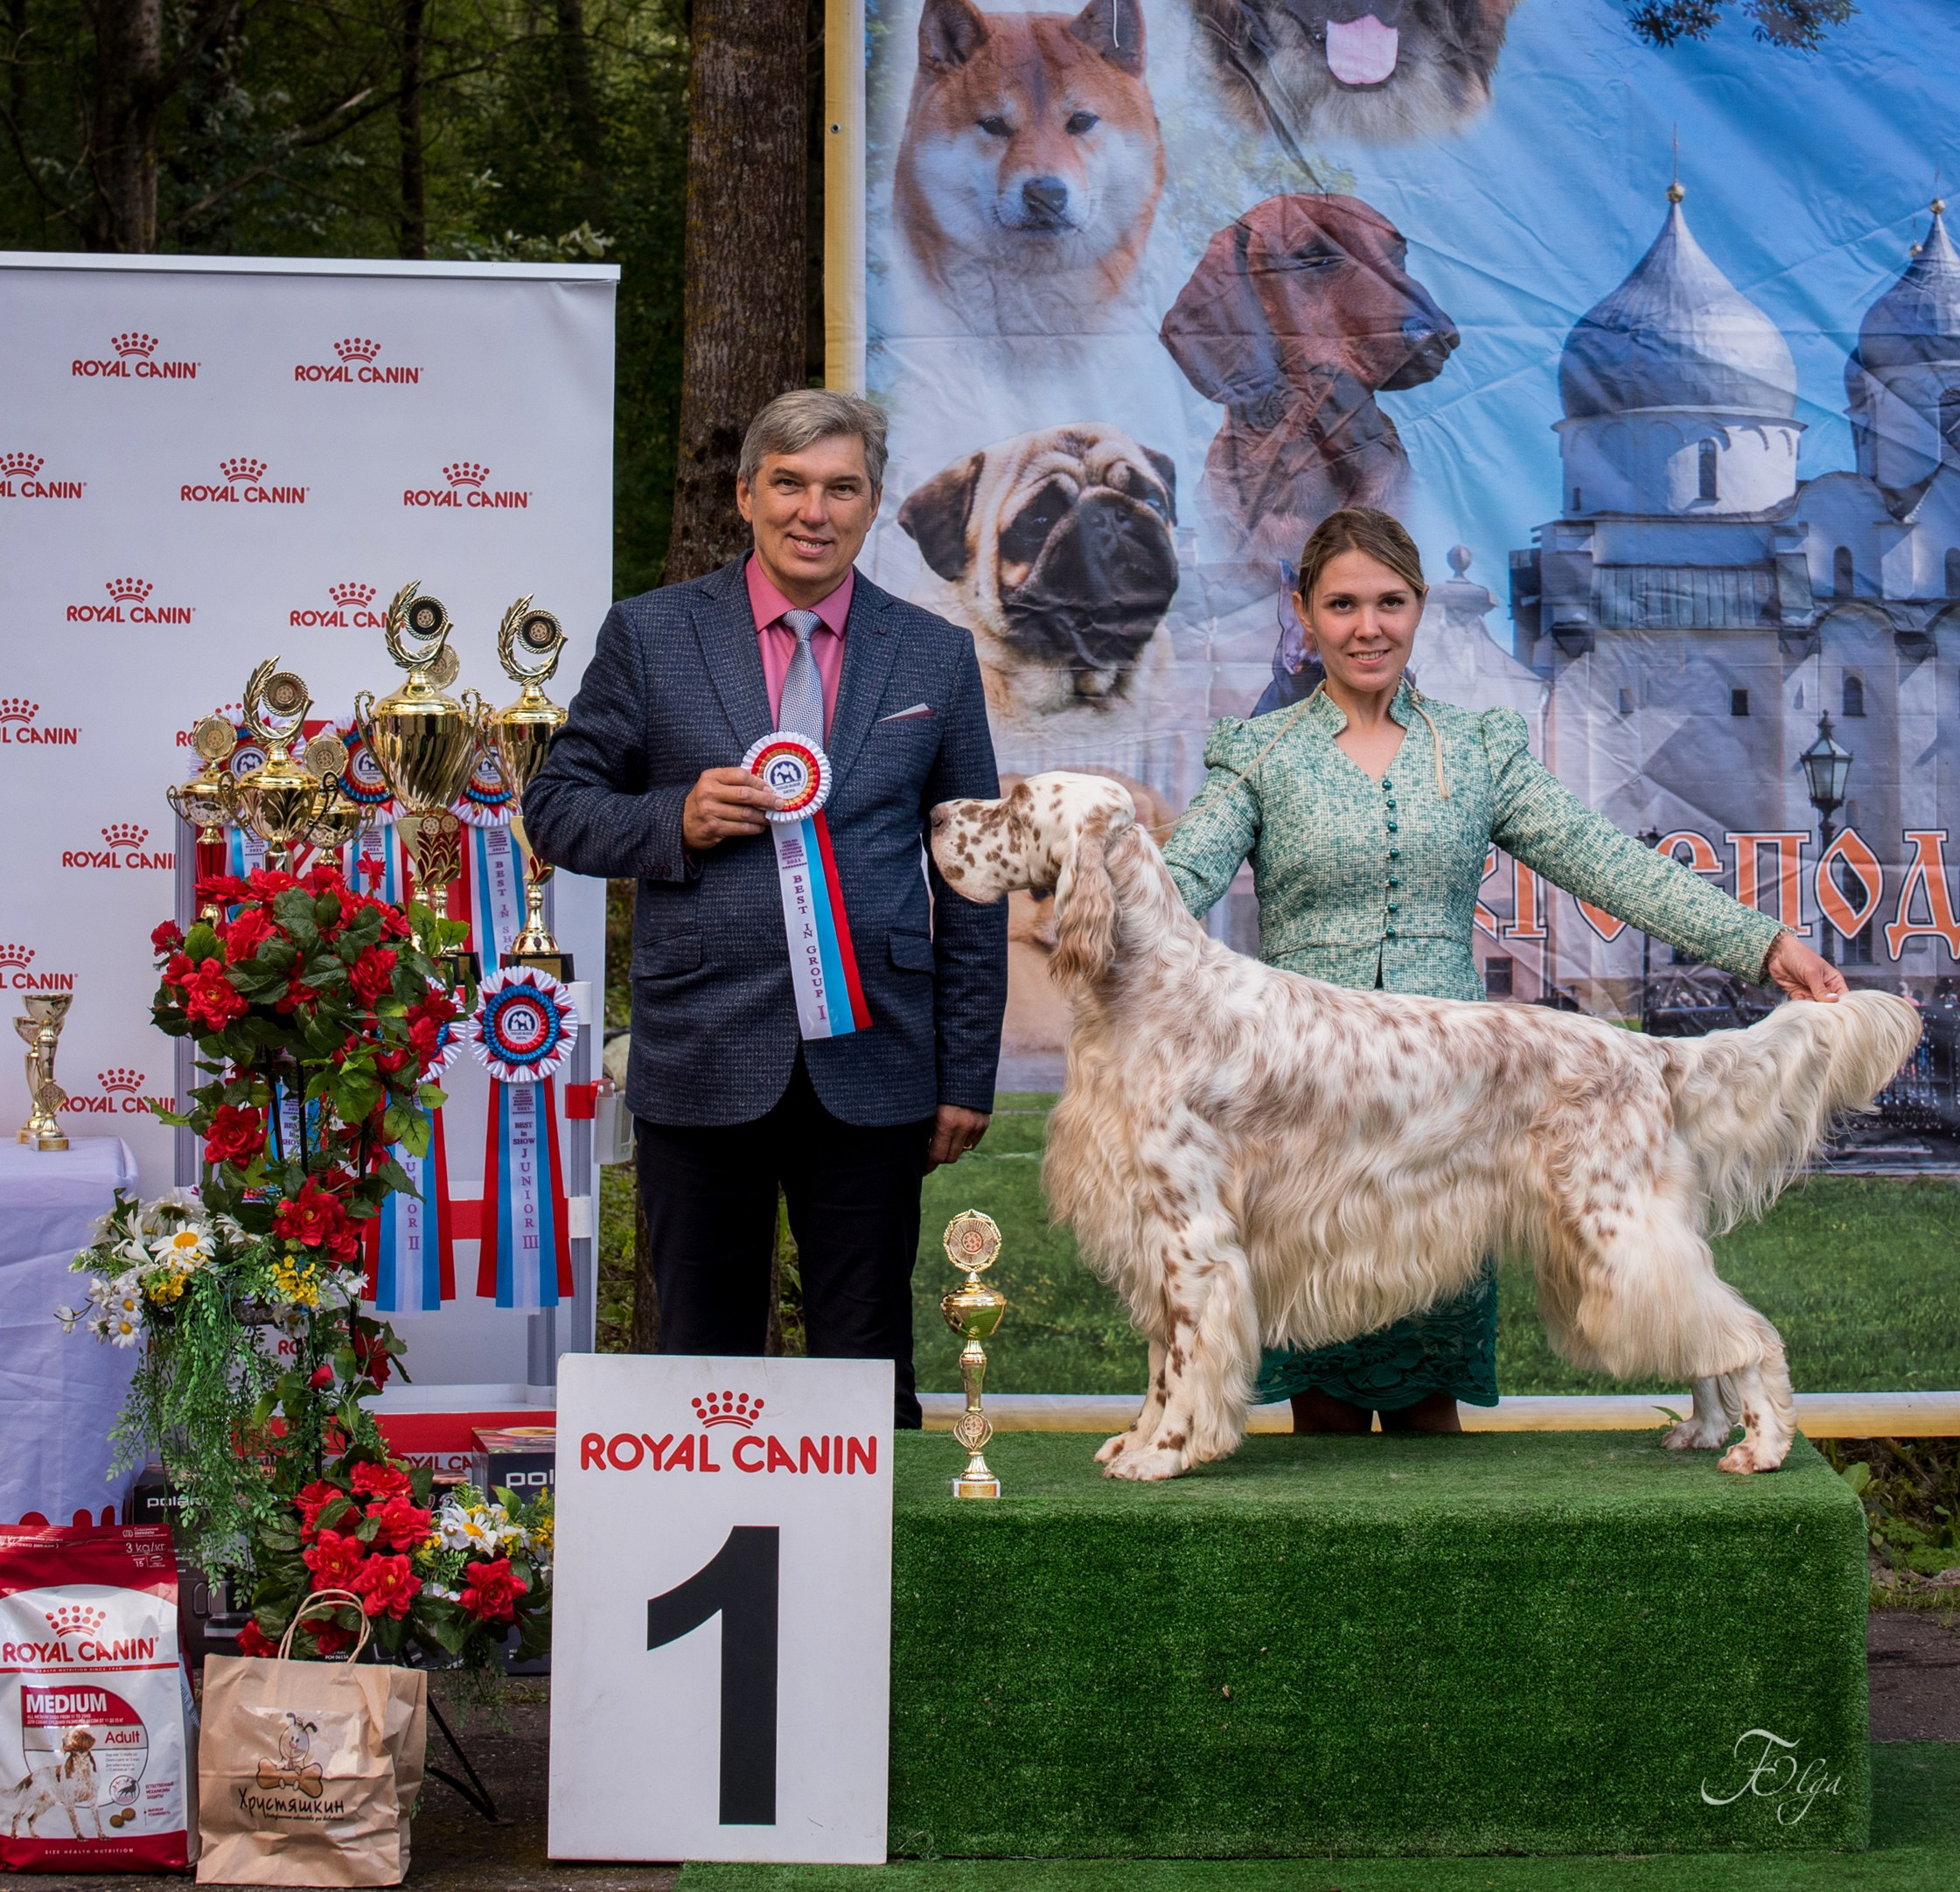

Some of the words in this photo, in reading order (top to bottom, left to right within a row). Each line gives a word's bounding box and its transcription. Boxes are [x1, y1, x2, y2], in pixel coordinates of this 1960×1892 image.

[72, 360, 130, 377] ROYAL
[135, 361, 197, 379] CANIN
[294, 365, 353, 382] ROYAL
[358, 366, 420, 384] CANIN
[21, 481, 82, 499] CANIN
[180, 484, 239, 503] ROYAL
[244, 485, 306, 504] CANIN
[403, 490, 462, 507] ROYAL
[466, 491, 528, 508] CANIN
[66, 605, 125, 623] ROYAL
[130, 606, 192, 625] CANIN
[289, 611, 349, 627] ROYAL
[16, 727, 77, 744] CANIN
[62, 851, 121, 868] ROYAL
[126, 852, 175, 869] CANI
[495, 861, 506, 896] BEST
[792, 875, 808, 914] BEST
[500, 904, 509, 918] IN
[502, 925, 513, 952] SHO
[803, 923, 813, 939] IN
[12, 973, 73, 990] CANIN
[806, 946, 824, 998] GROUP
[520, 1148, 534, 1228] JUNIOR
[408, 1236, 420, 1250] II
[522, 1235, 539, 1249] III
[580, 1432, 722, 1472] ROYAL
[731, 1435, 878, 1475] CANIN
[125, 1542, 133, 1553] 3
[3, 1642, 74, 1663] ROYAL
[78, 1637, 154, 1661] CANIN
[646, 1525, 780, 1826] 1
[26, 1693, 107, 1714] MEDIUM
[104, 1731, 140, 1743] Adult
[238, 1787, 345, 1819] Хрустяшкин
